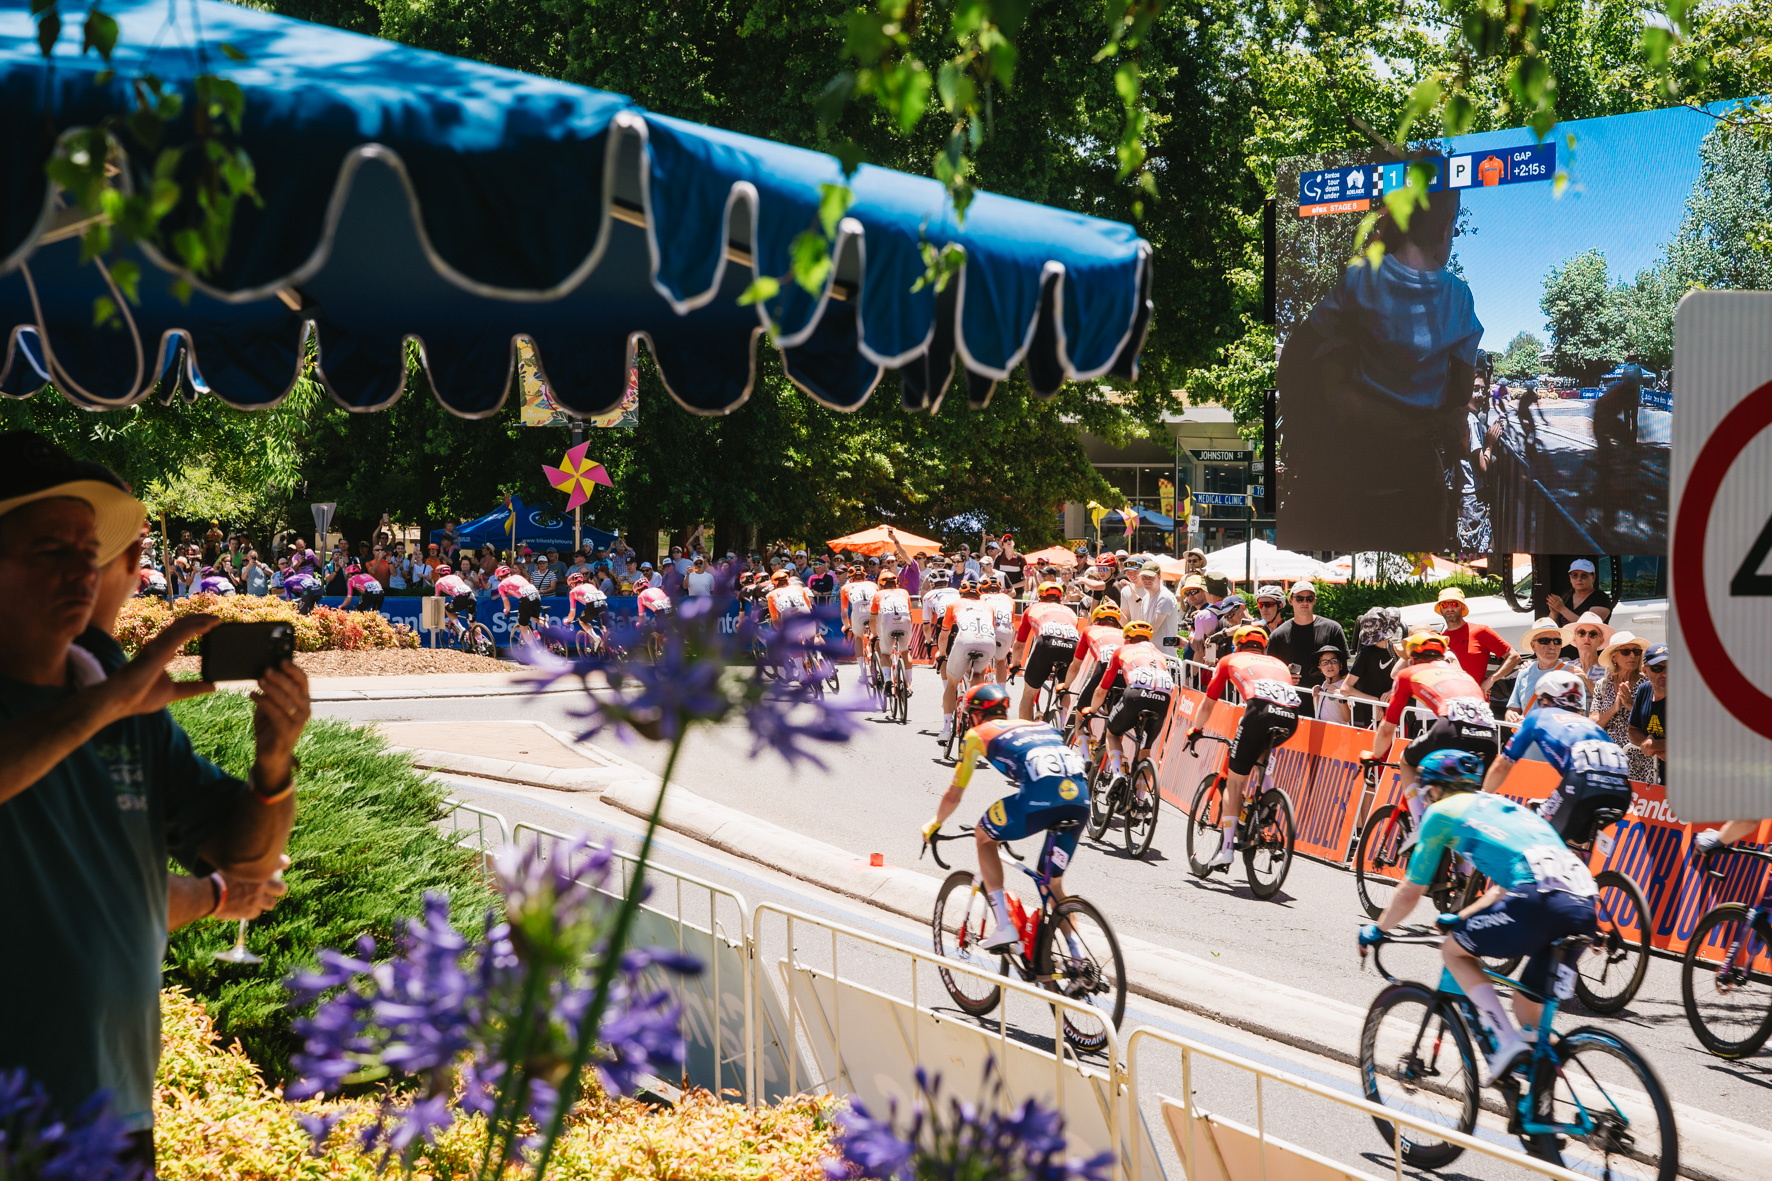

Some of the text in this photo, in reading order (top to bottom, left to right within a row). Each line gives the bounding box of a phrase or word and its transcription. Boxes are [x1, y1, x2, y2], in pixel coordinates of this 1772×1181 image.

[1513, 151, 1532, 162] GAP
[1456, 164, 1466, 178] P
[1389, 170, 1397, 186] 1
[1330, 203, 1352, 212] STAGE
[1199, 451, 1234, 460] JOHNSTON
[1197, 495, 1243, 505] MEDICAL CLINIC
[1043, 626, 1062, 636] 165
